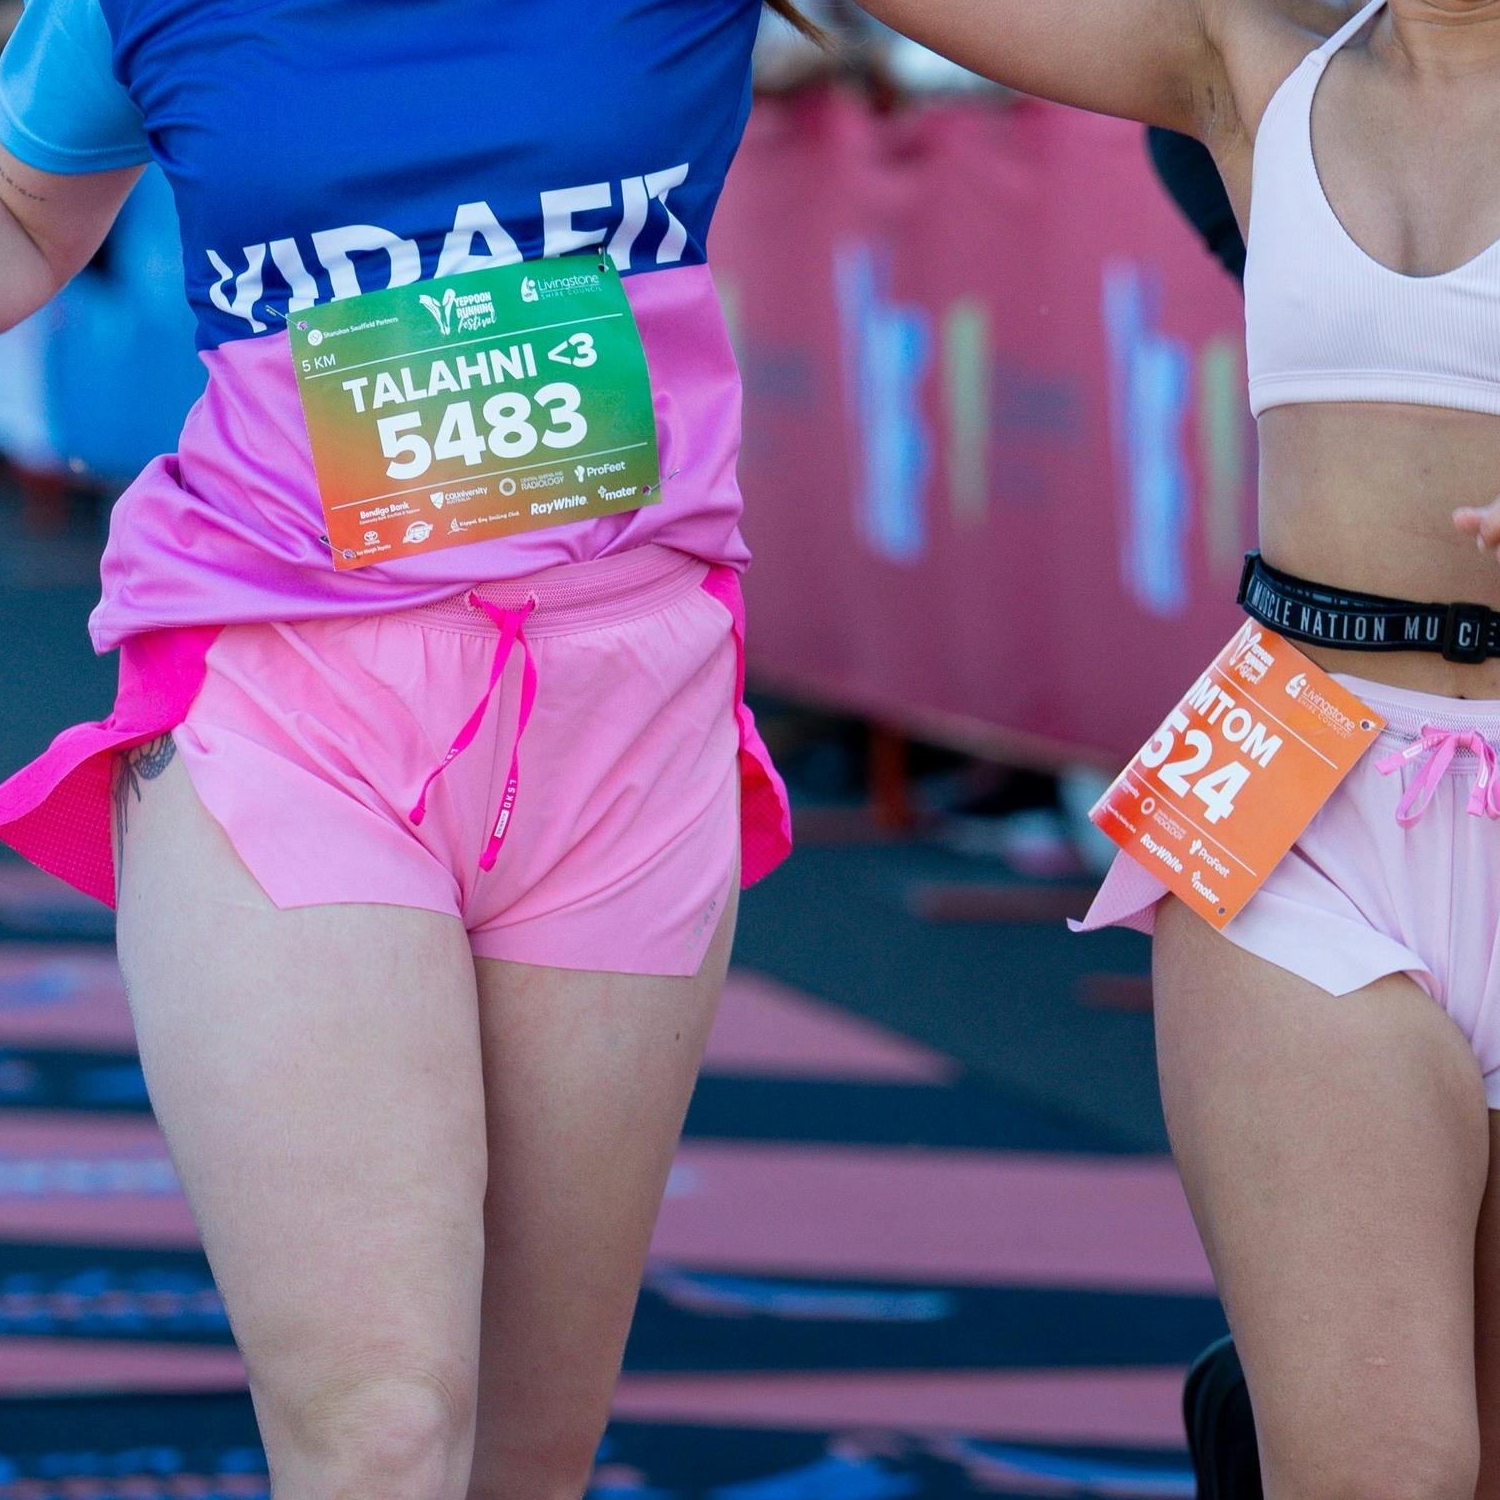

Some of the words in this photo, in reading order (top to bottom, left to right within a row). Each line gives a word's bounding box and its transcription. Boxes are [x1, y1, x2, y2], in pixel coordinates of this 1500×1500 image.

[537, 274, 600, 291] Livingstone
[568, 286, 602, 296] COUNCIL
[454, 291, 492, 308] YEPPOON
[456, 302, 495, 319] RUNNING
[376, 316, 399, 328] Partners
[302, 360, 311, 373] 5
[314, 353, 337, 370] KM
[342, 343, 538, 413] TALAHNI
[547, 332, 599, 367] <3
[376, 382, 588, 481] 5483
[587, 461, 626, 477] ProFeet
[521, 475, 564, 491] RADIOLOGY
[605, 485, 638, 501] mater
[359, 506, 389, 520] Bendigo
[389, 501, 410, 513] Bank
[1251, 580, 1290, 627] MUSCLE
[1300, 607, 1386, 642] NATION
[1302, 684, 1356, 733] Livingstone
[1198, 847, 1230, 878] ProFeet
[1192, 879, 1220, 905] mater
